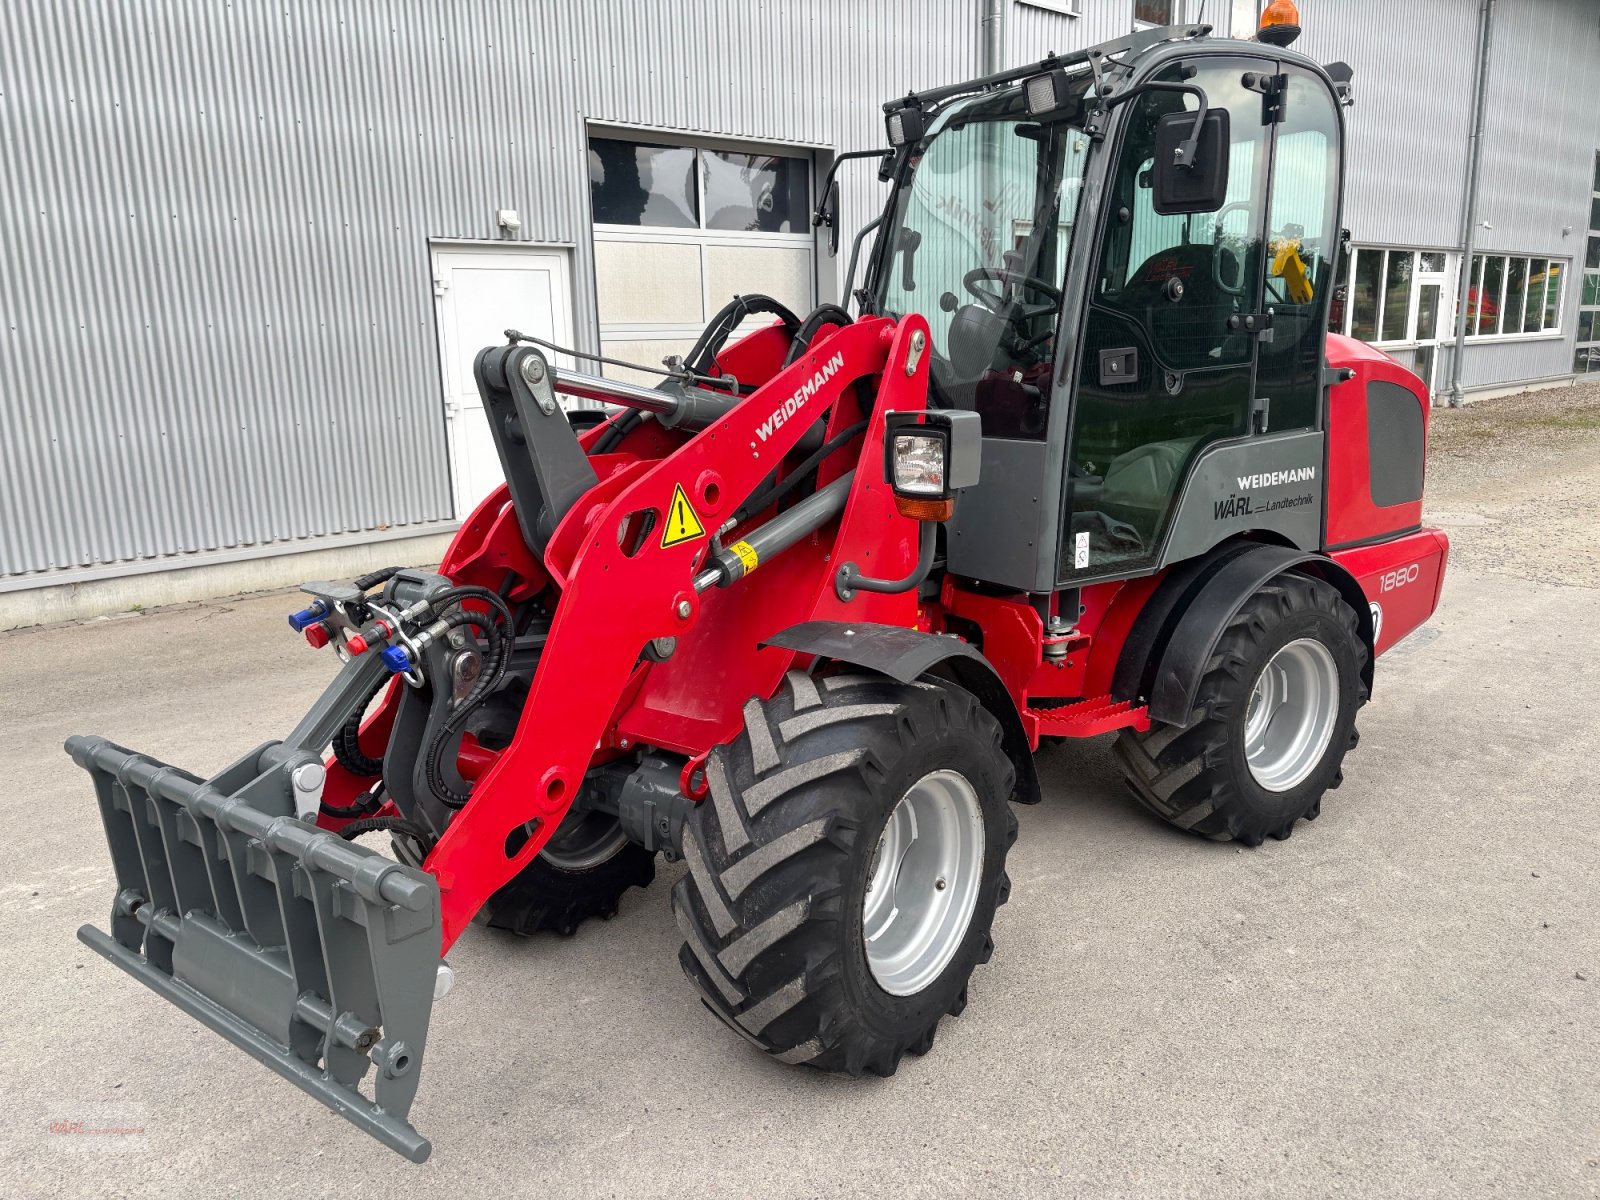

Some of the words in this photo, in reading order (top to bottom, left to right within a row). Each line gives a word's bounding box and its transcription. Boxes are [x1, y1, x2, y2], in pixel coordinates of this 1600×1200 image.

[755, 351, 844, 442] WEIDEMANN
[1237, 466, 1315, 490] WEIDEMANN
[1214, 494, 1253, 520] WÄRL
[1265, 493, 1314, 512] Landtechnik
[1380, 563, 1419, 593] 1880
